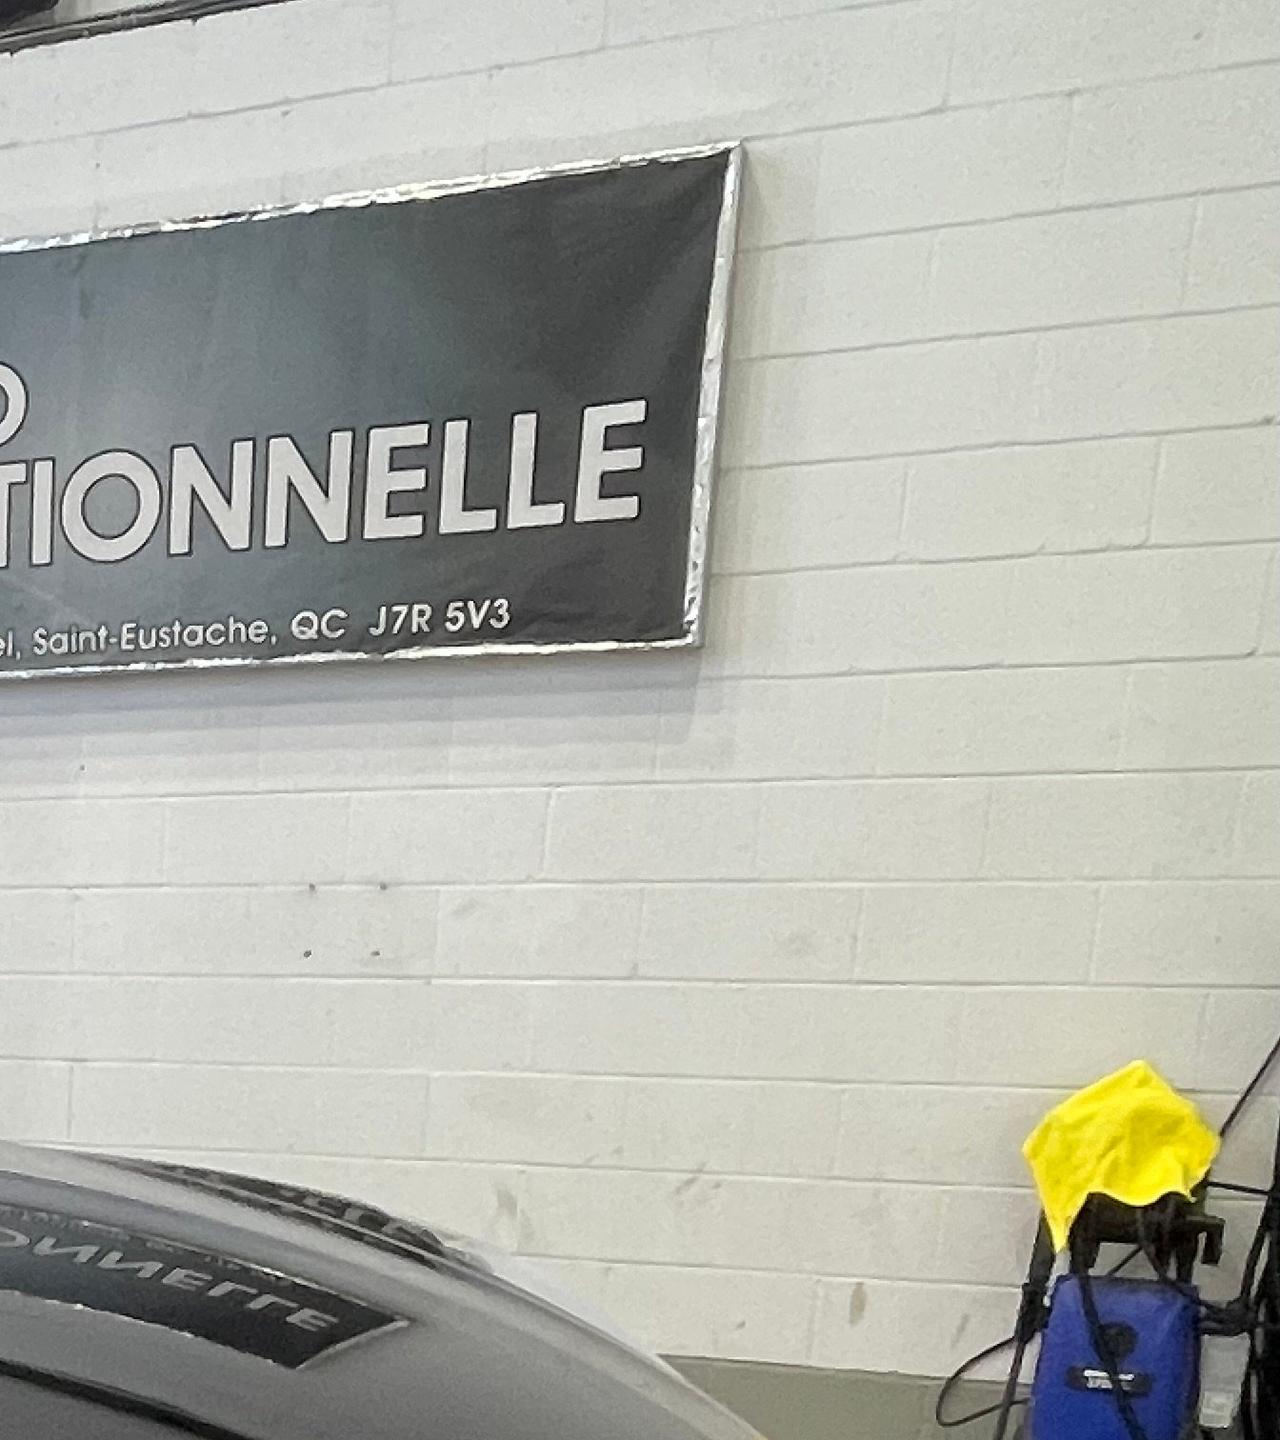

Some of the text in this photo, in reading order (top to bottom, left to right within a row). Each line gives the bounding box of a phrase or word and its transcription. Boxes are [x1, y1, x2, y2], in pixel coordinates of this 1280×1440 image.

[30, 615, 278, 657] Saint-Eustache,
[289, 608, 349, 641] QC
[368, 603, 433, 637] J7R
[444, 597, 511, 632] 5V3
